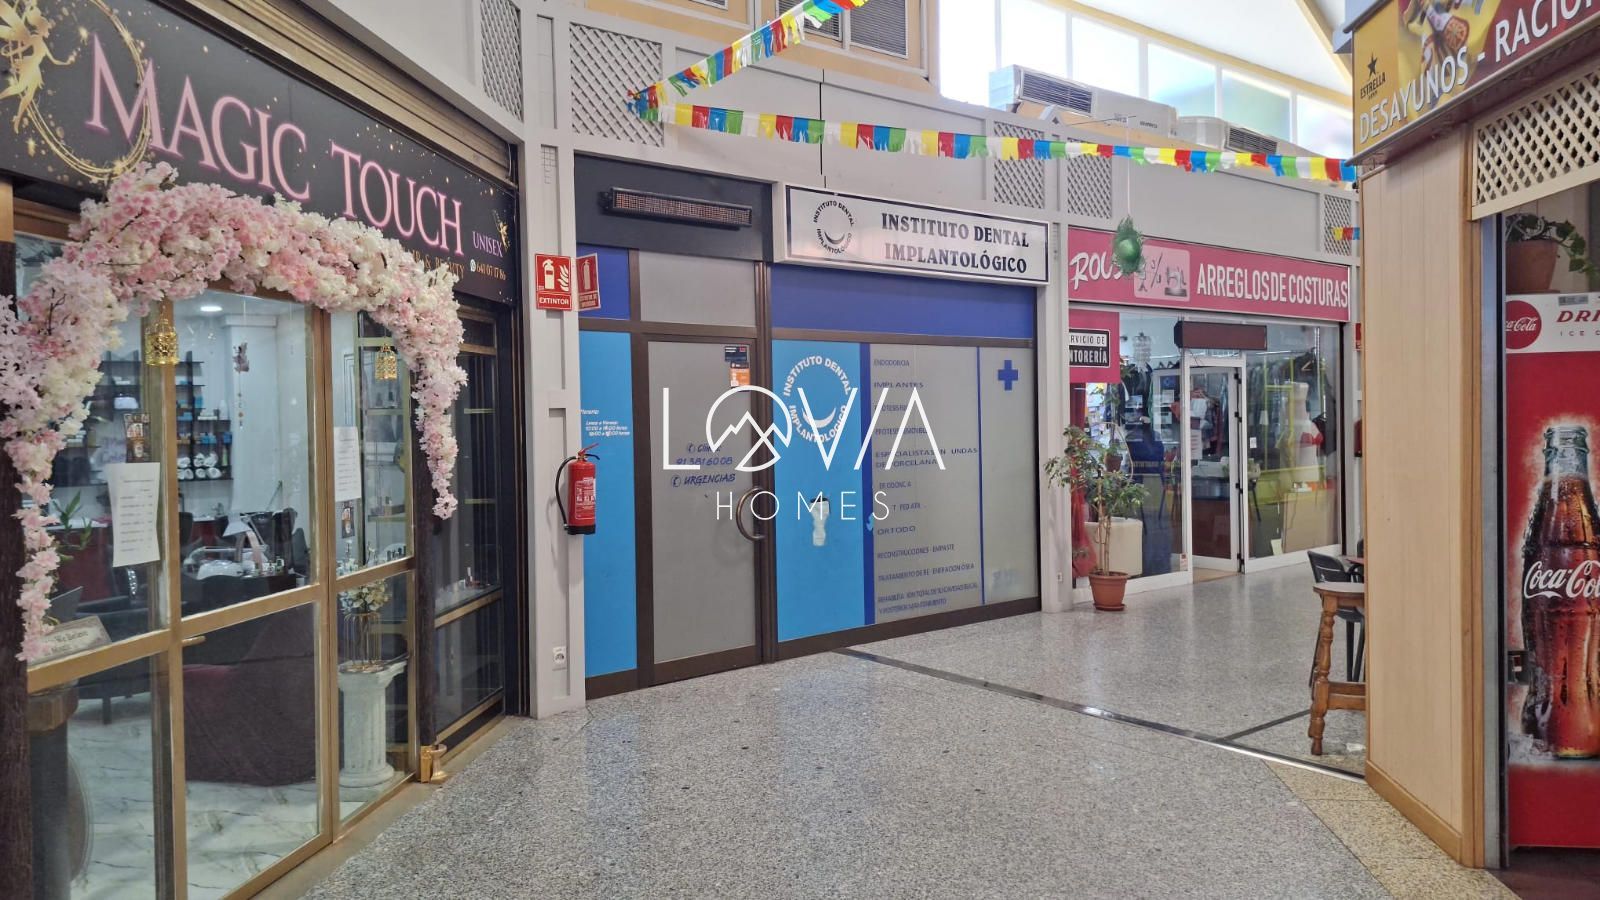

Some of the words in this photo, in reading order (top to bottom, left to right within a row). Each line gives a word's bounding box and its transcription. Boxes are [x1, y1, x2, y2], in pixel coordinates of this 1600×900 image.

[1360, 46, 1469, 143] DESAYUNOS
[1495, 0, 1592, 62] RACIO
[1360, 71, 1386, 99] ESTRELLA
[85, 33, 310, 200] MAGIC
[330, 144, 465, 256] TOUCH
[813, 200, 838, 223] INSTITUTO
[837, 202, 854, 227] DENTAL
[472, 231, 503, 257] UNISEX
[881, 212, 969, 240] INSTITUTO
[974, 226, 1030, 247] DENTAL
[884, 242, 1027, 274] IMPLANTOLÓGICO
[539, 297, 569, 305] EXTINTOR
[1288, 274, 1348, 308] COSTURAS
[1097, 336, 1105, 345] DE
[783, 356, 823, 396] INSTITUTO
[824, 358, 851, 395] DENTAL
[684, 473, 736, 486] URGENCIAS
